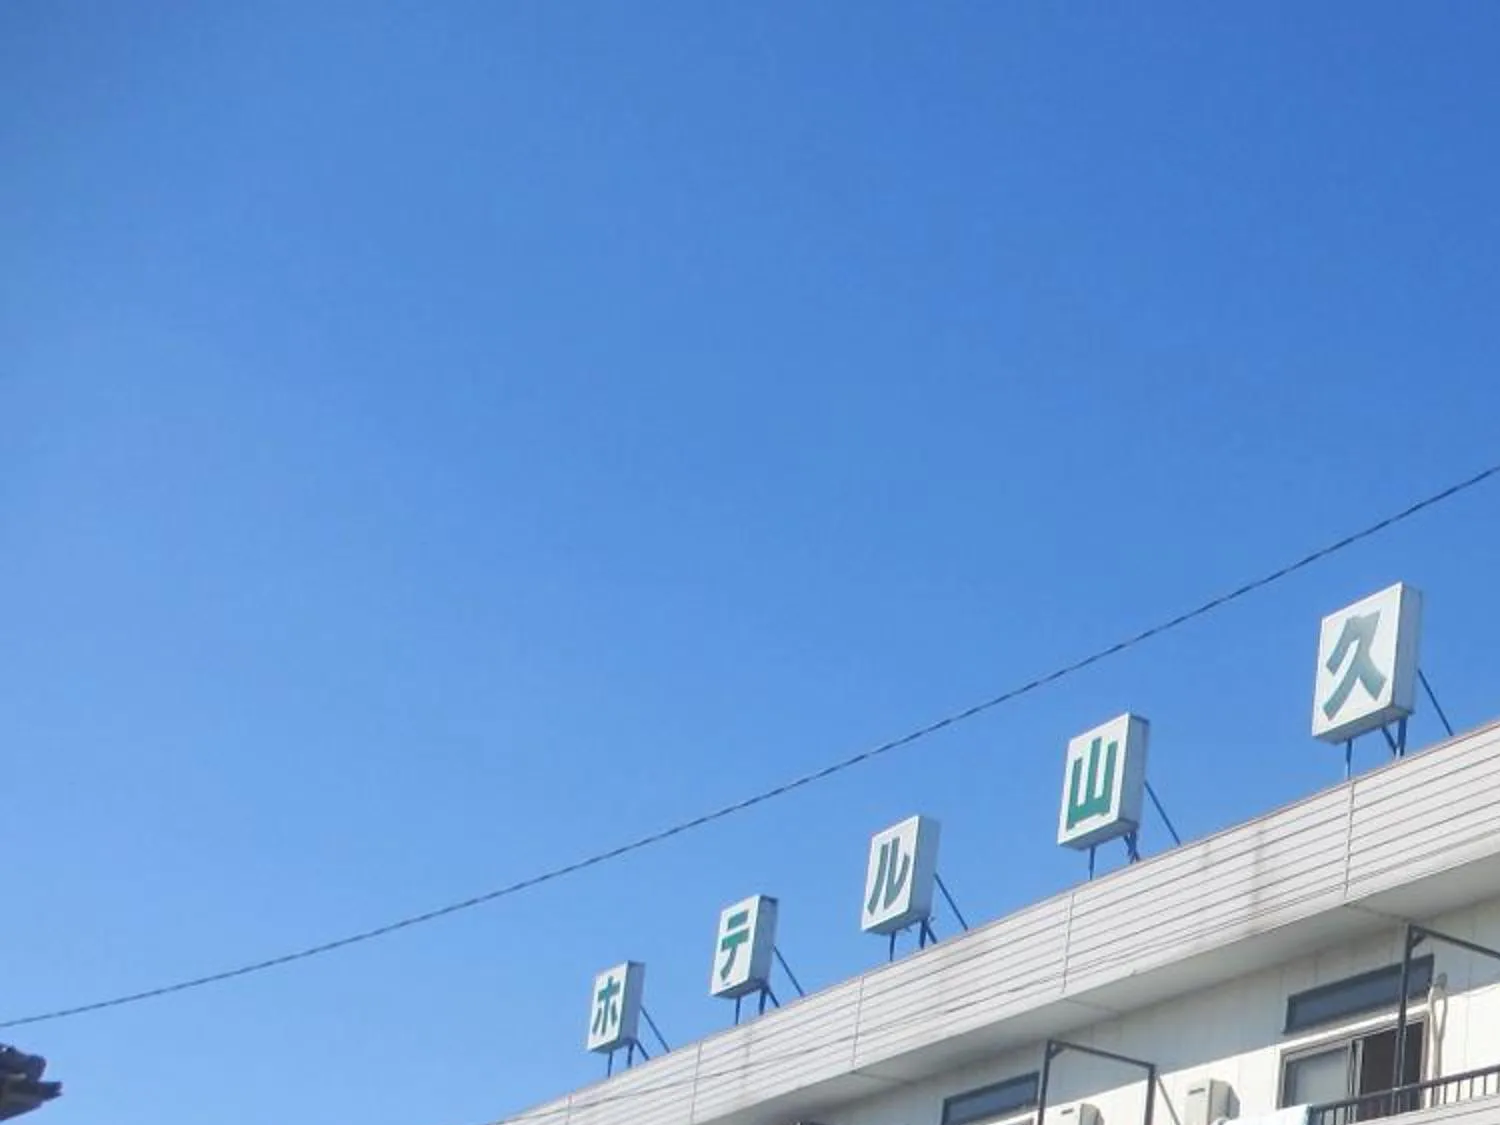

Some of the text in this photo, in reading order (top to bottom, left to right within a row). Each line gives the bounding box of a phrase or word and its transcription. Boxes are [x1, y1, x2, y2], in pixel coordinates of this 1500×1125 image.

[592, 609, 1388, 1035] ホ テ ル 山 久
